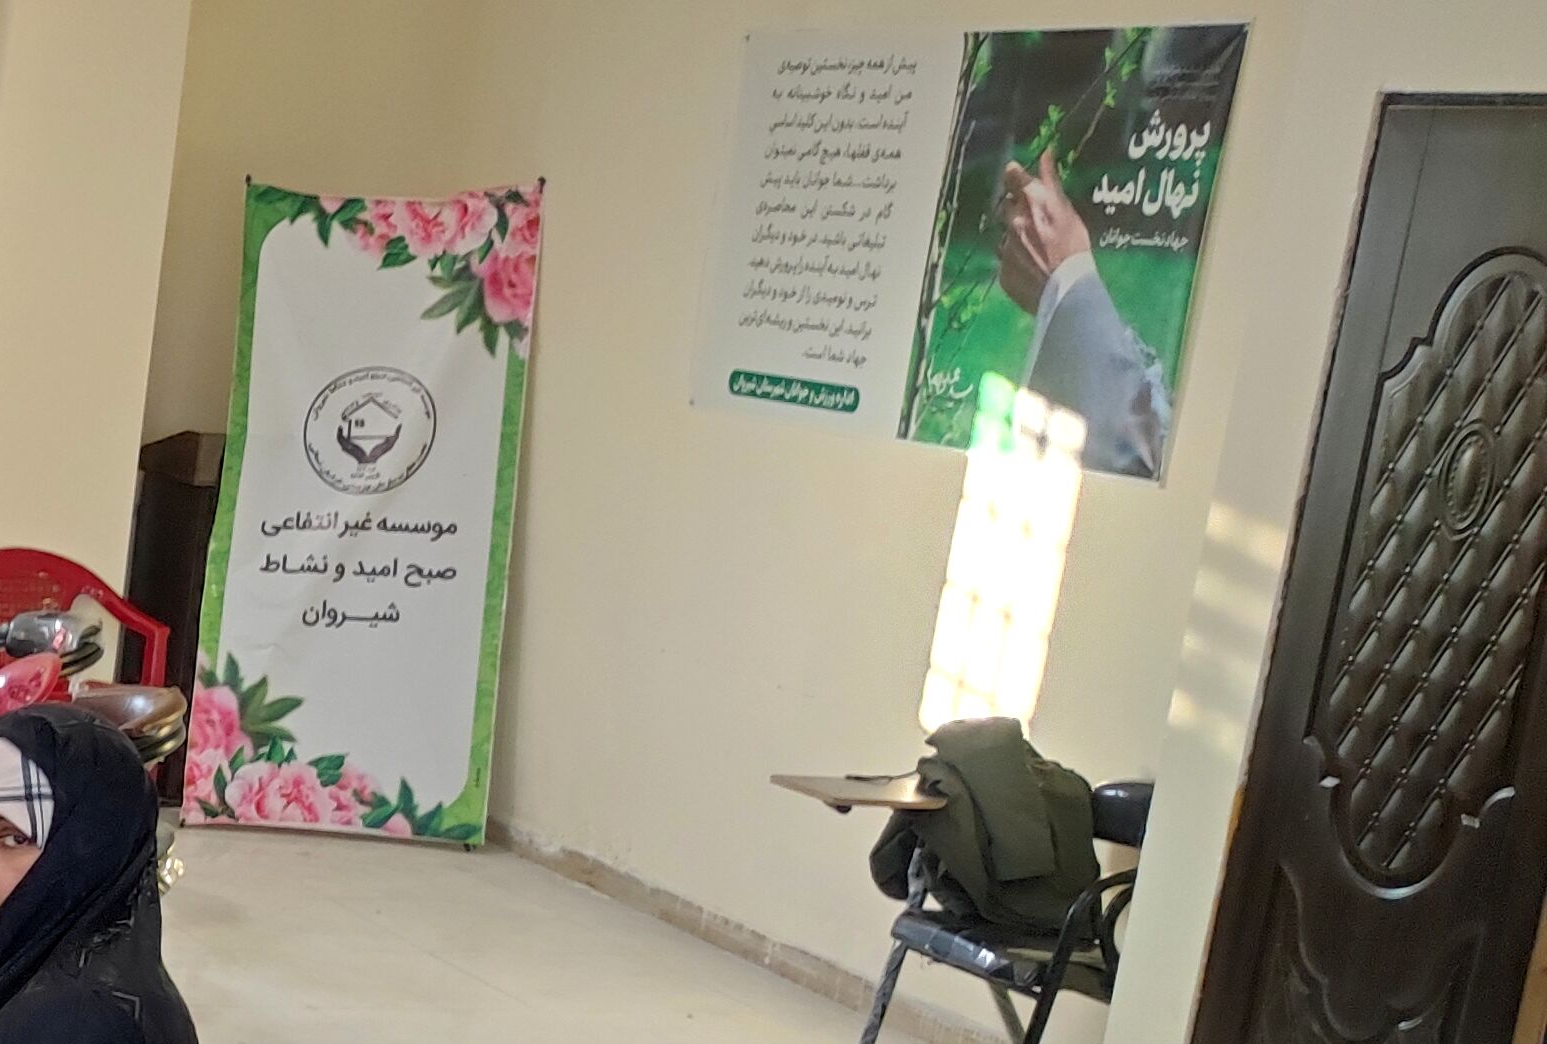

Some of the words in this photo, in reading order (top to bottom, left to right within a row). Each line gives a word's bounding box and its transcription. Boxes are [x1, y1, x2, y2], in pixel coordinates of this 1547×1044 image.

[811, 57, 847, 76] نخستین
[866, 59, 885, 70] همه
[892, 56, 918, 76] پیش
[771, 88, 783, 101] به
[836, 82, 857, 100] نگاه
[858, 90, 865, 104] و
[869, 84, 893, 104] امید
[894, 90, 912, 105] من
[796, 112, 817, 132] کلید
[814, 112, 833, 133] این
[832, 118, 854, 132] بدون
[882, 110, 909, 134] آینده
[1128, 108, 1211, 166] پرورش
[797, 139, 822, 161] گامی
[819, 147, 841, 165] هیچ
[782, 170, 800, 189] باید
[803, 170, 830, 191] جوانان
[1092, 166, 1147, 215] امید
[1142, 168, 1200, 220] نهال
[800, 199, 818, 220] این
[821, 200, 856, 220] شکستن
[858, 207, 872, 222] در
[875, 201, 894, 226] گام
[751, 223, 780, 244] دیگران
[788, 231, 807, 246] خود
[806, 233, 818, 247] در
[847, 231, 887, 252] تبلیغاتی
[1099, 226, 1131, 249] جوانان
[1130, 231, 1166, 247] نخست
[1165, 230, 1189, 252] جهاد
[806, 254, 830, 276] آینده
[827, 262, 838, 278] به
[839, 261, 860, 279] امید
[859, 261, 882, 281] نهال
[743, 279, 772, 299] دیگران
[779, 287, 797, 302] خود
[846, 296, 853, 309] و
[854, 293, 878, 312] ترس
[793, 316, 829, 333] نخستین
[829, 318, 845, 338] این
[827, 345, 844, 362] شما
[846, 346, 867, 368] جهاد
[732, 372, 756, 394] شیروان
[755, 375, 786, 399] شهرستان
[784, 379, 809, 403] جوانان
[815, 386, 837, 408] ورزش
[837, 389, 856, 409] اداره
[261, 510, 339, 536] انتفاعی
[338, 511, 372, 538] غیر
[376, 516, 457, 542] موسسه
[259, 553, 328, 574] نشاط
[333, 562, 345, 583] و
[352, 557, 398, 583] امید
[404, 563, 457, 587] صبح
[302, 599, 400, 629] شیروان
